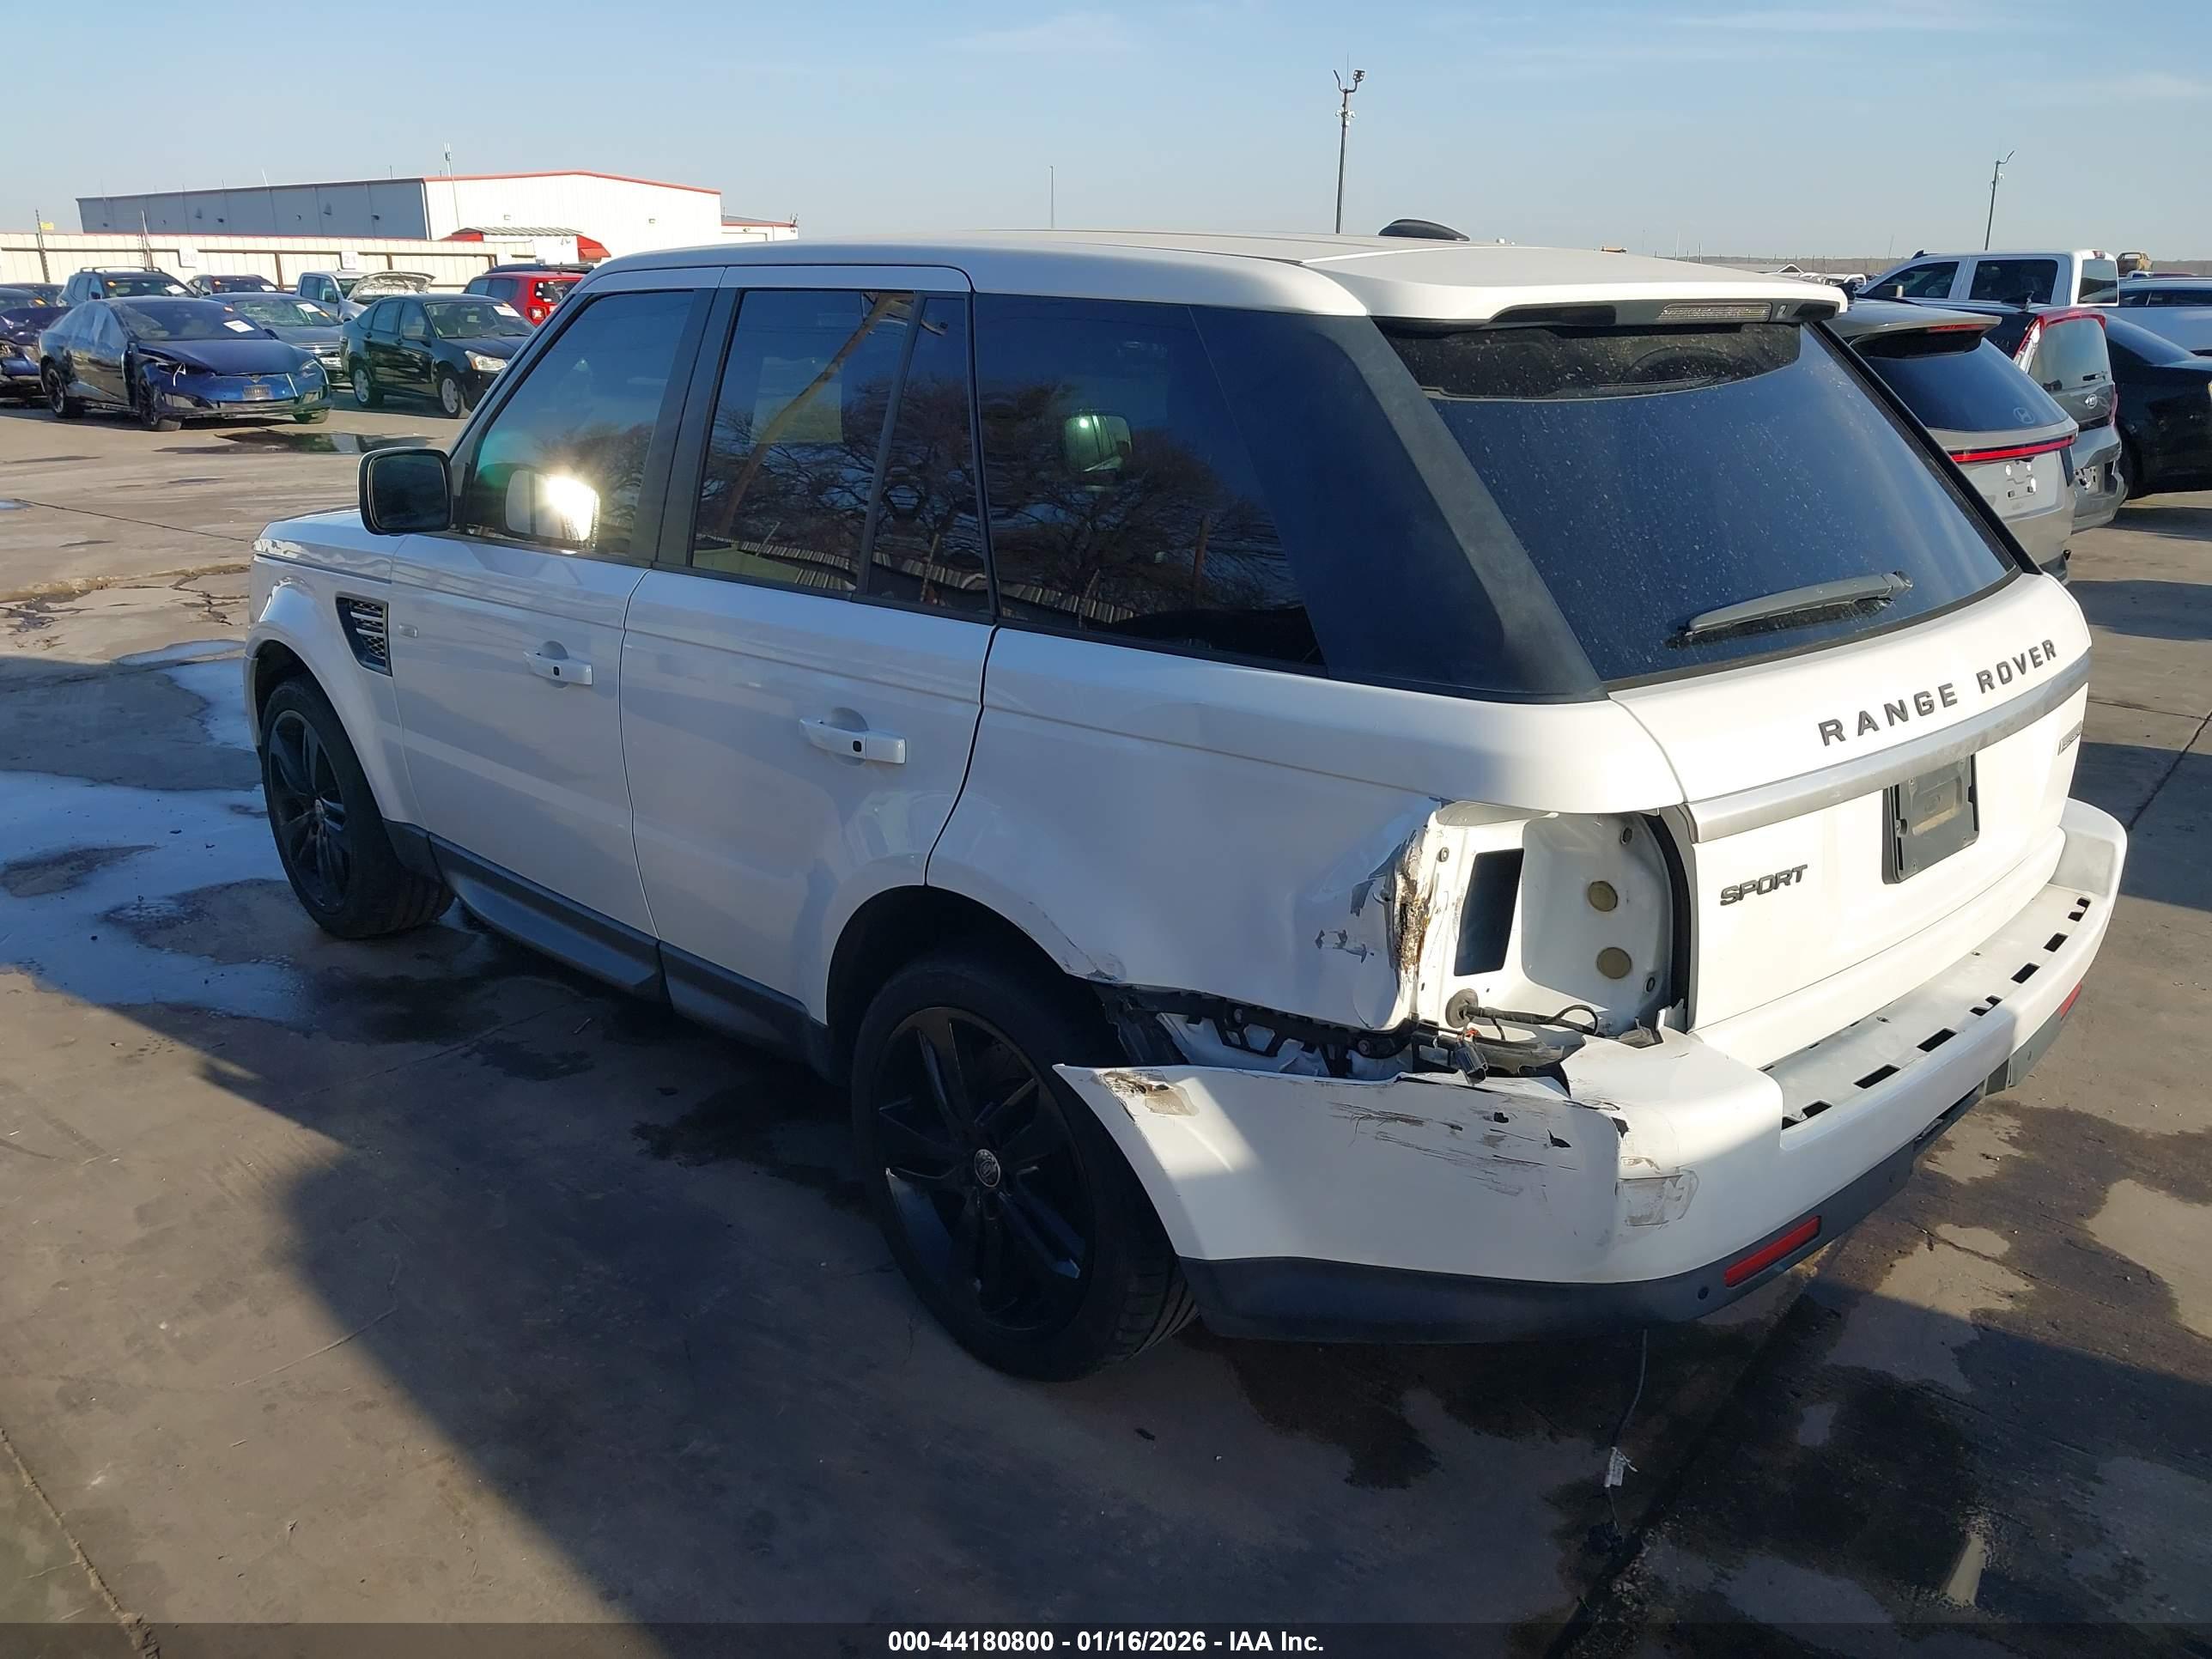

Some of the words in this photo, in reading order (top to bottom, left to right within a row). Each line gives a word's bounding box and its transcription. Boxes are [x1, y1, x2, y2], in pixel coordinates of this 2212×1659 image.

[1818, 683, 1958, 746] RANGE
[1976, 639, 2057, 694] ROVER
[1720, 864, 1808, 906] SPORT
